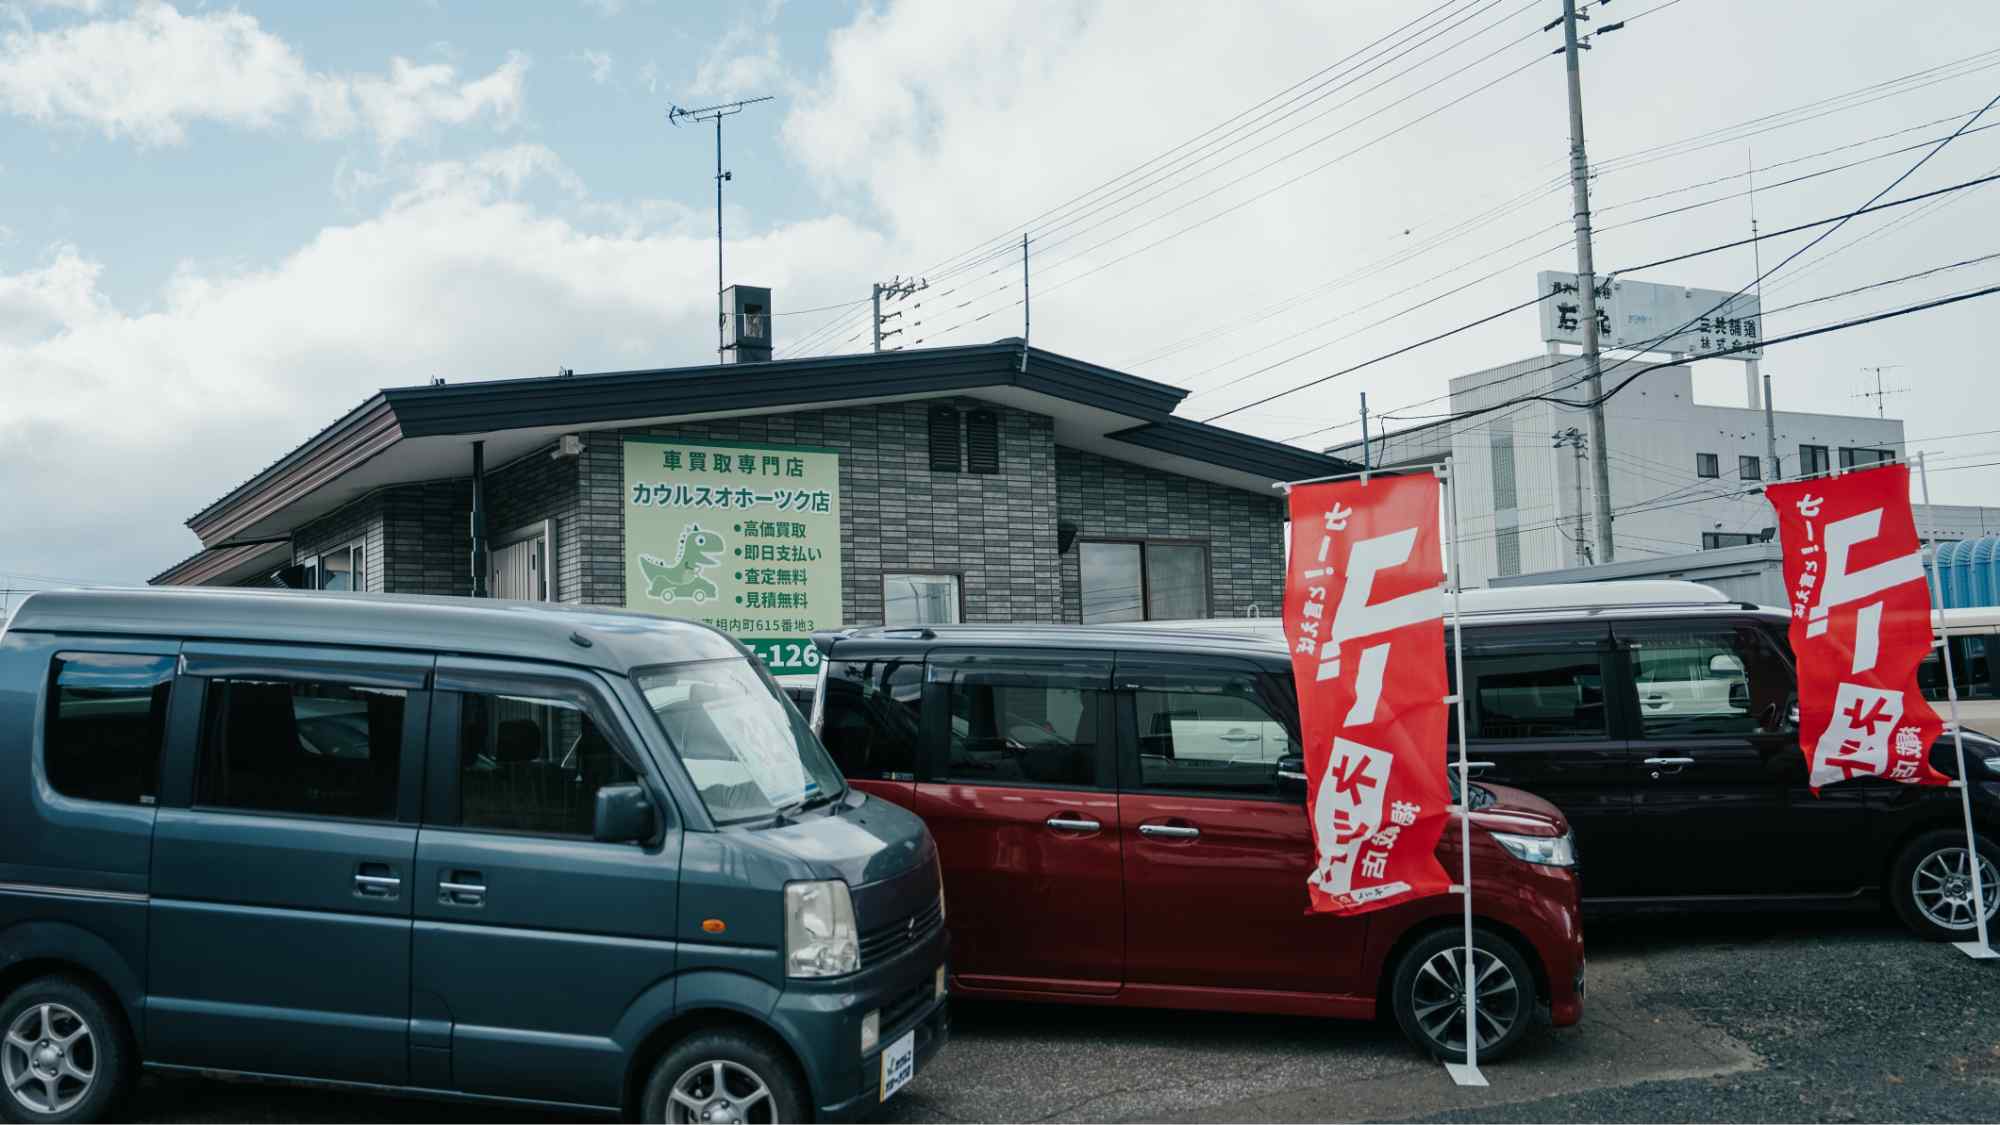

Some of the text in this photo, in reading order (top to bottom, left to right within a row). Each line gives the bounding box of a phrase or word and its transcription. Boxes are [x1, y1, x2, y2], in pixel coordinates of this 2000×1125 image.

[662, 449, 804, 478] 車買取専門店
[632, 483, 831, 512] カウルスオホーツク店
[743, 520, 807, 539] 高価買取
[744, 544, 822, 562] 即日支払い
[744, 568, 808, 586] 査定無料
[745, 591, 809, 609] 見積無料
